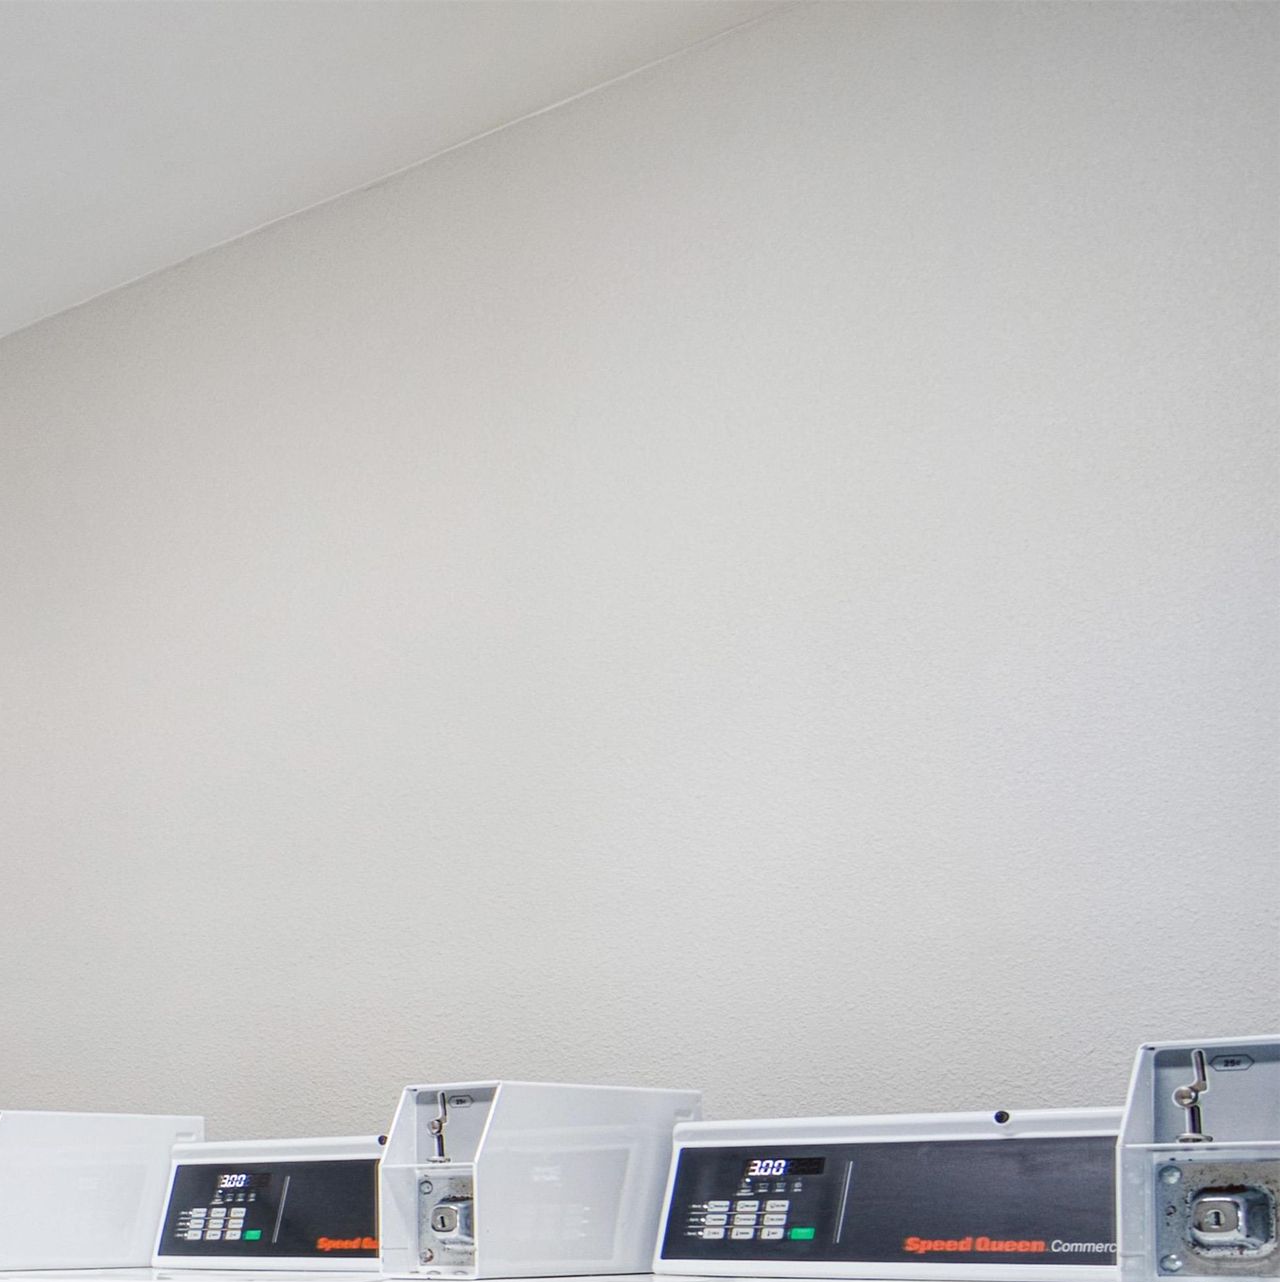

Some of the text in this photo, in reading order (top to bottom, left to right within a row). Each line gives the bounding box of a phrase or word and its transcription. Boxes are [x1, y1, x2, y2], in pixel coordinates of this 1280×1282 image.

[748, 1160, 786, 1176] 3.00
[317, 1237, 361, 1252] Speed
[905, 1237, 972, 1254] Speed
[975, 1237, 1046, 1252] Queen
